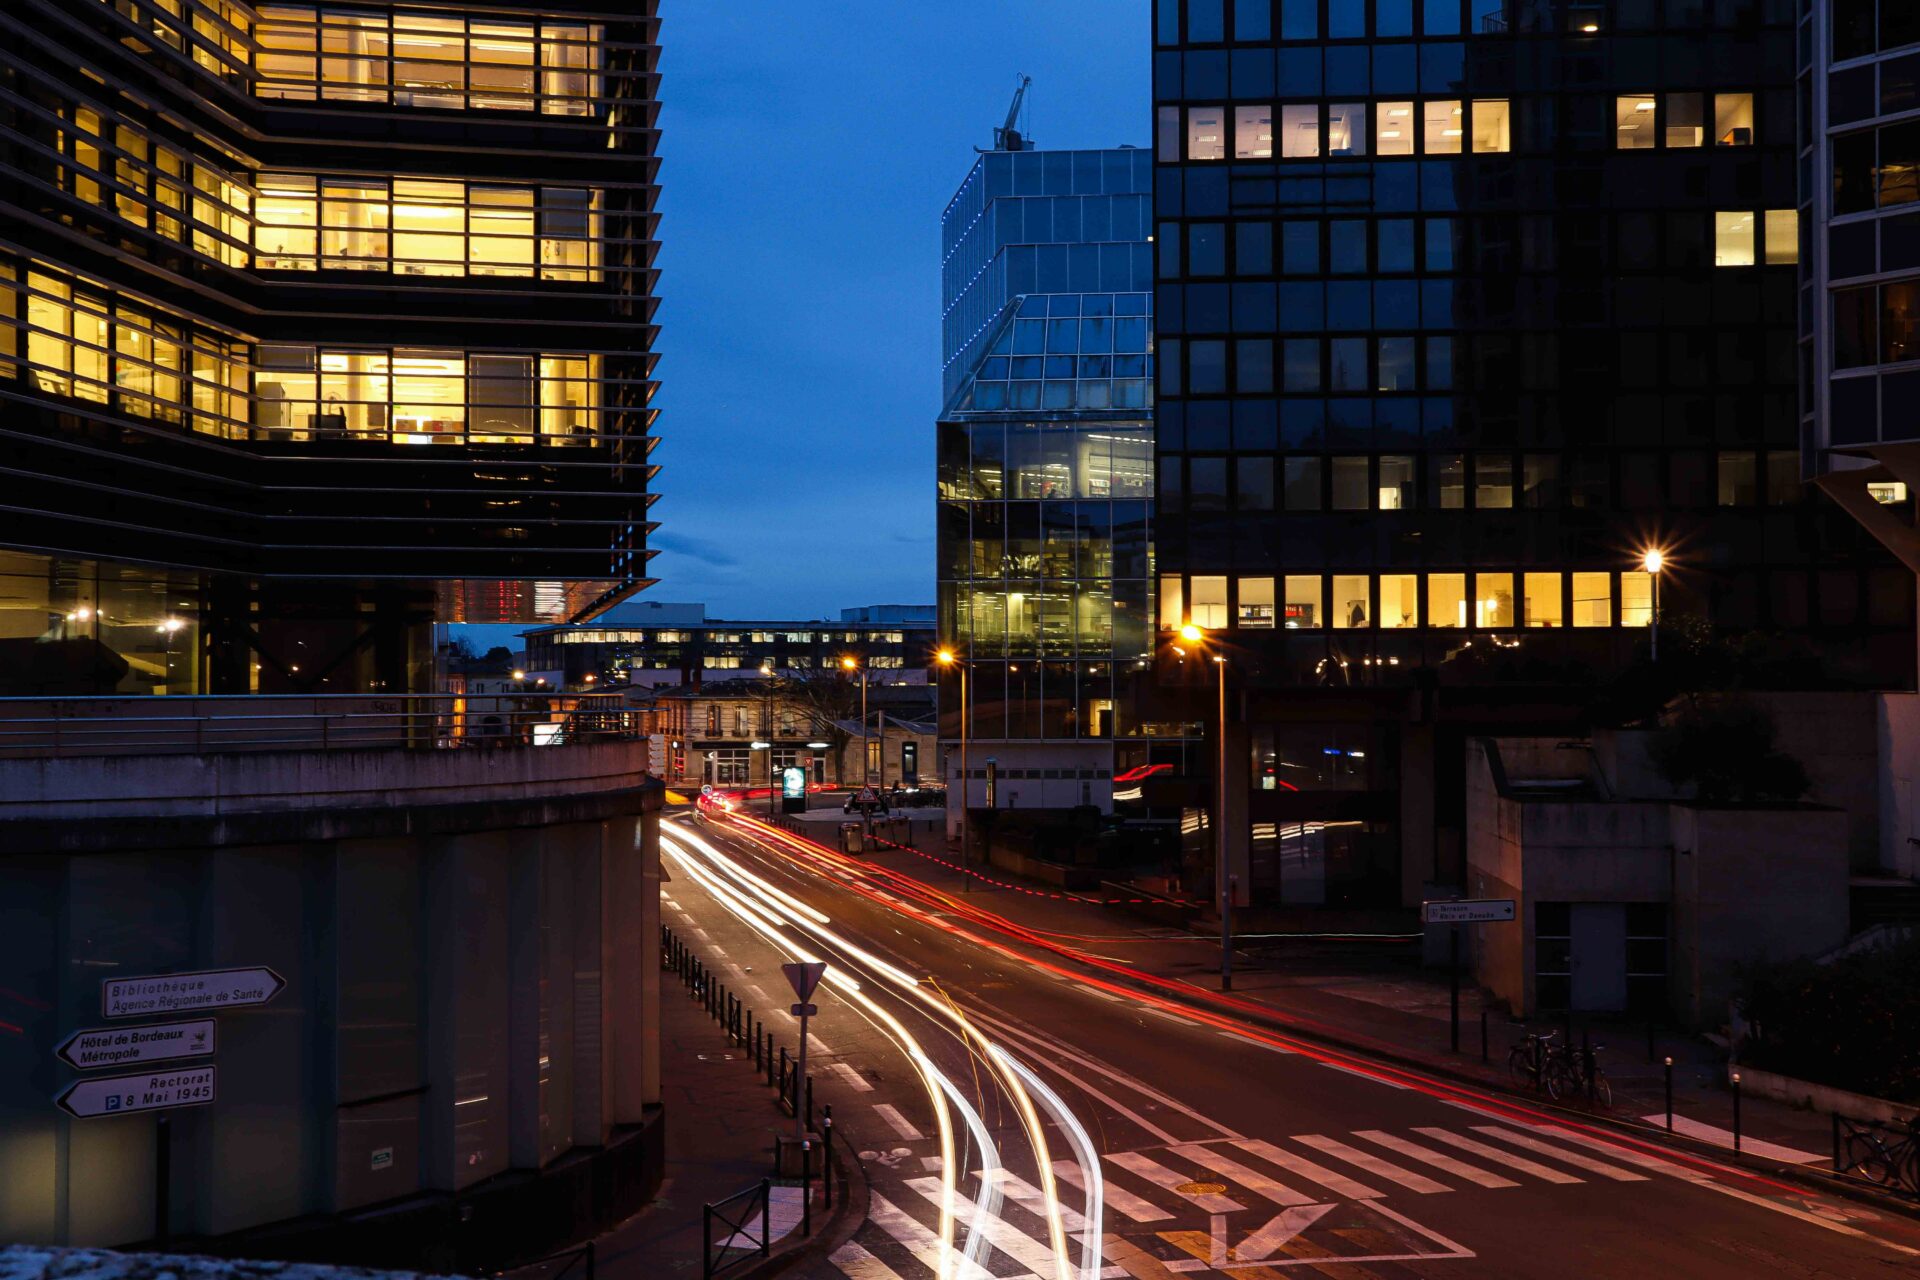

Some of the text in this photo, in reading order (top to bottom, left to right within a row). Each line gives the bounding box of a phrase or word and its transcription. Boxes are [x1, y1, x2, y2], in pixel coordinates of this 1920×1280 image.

[112, 981, 204, 997] Bibliothèque
[112, 987, 263, 1013] Agence Régionale de Santé
[80, 1030, 183, 1048] Hôtel de Bordeaux
[80, 1047, 139, 1063] Métropole
[150, 1073, 210, 1089] Rectorat
[126, 1095, 134, 1106] 8
[143, 1092, 168, 1104] Mai
[177, 1086, 210, 1100] 1945
